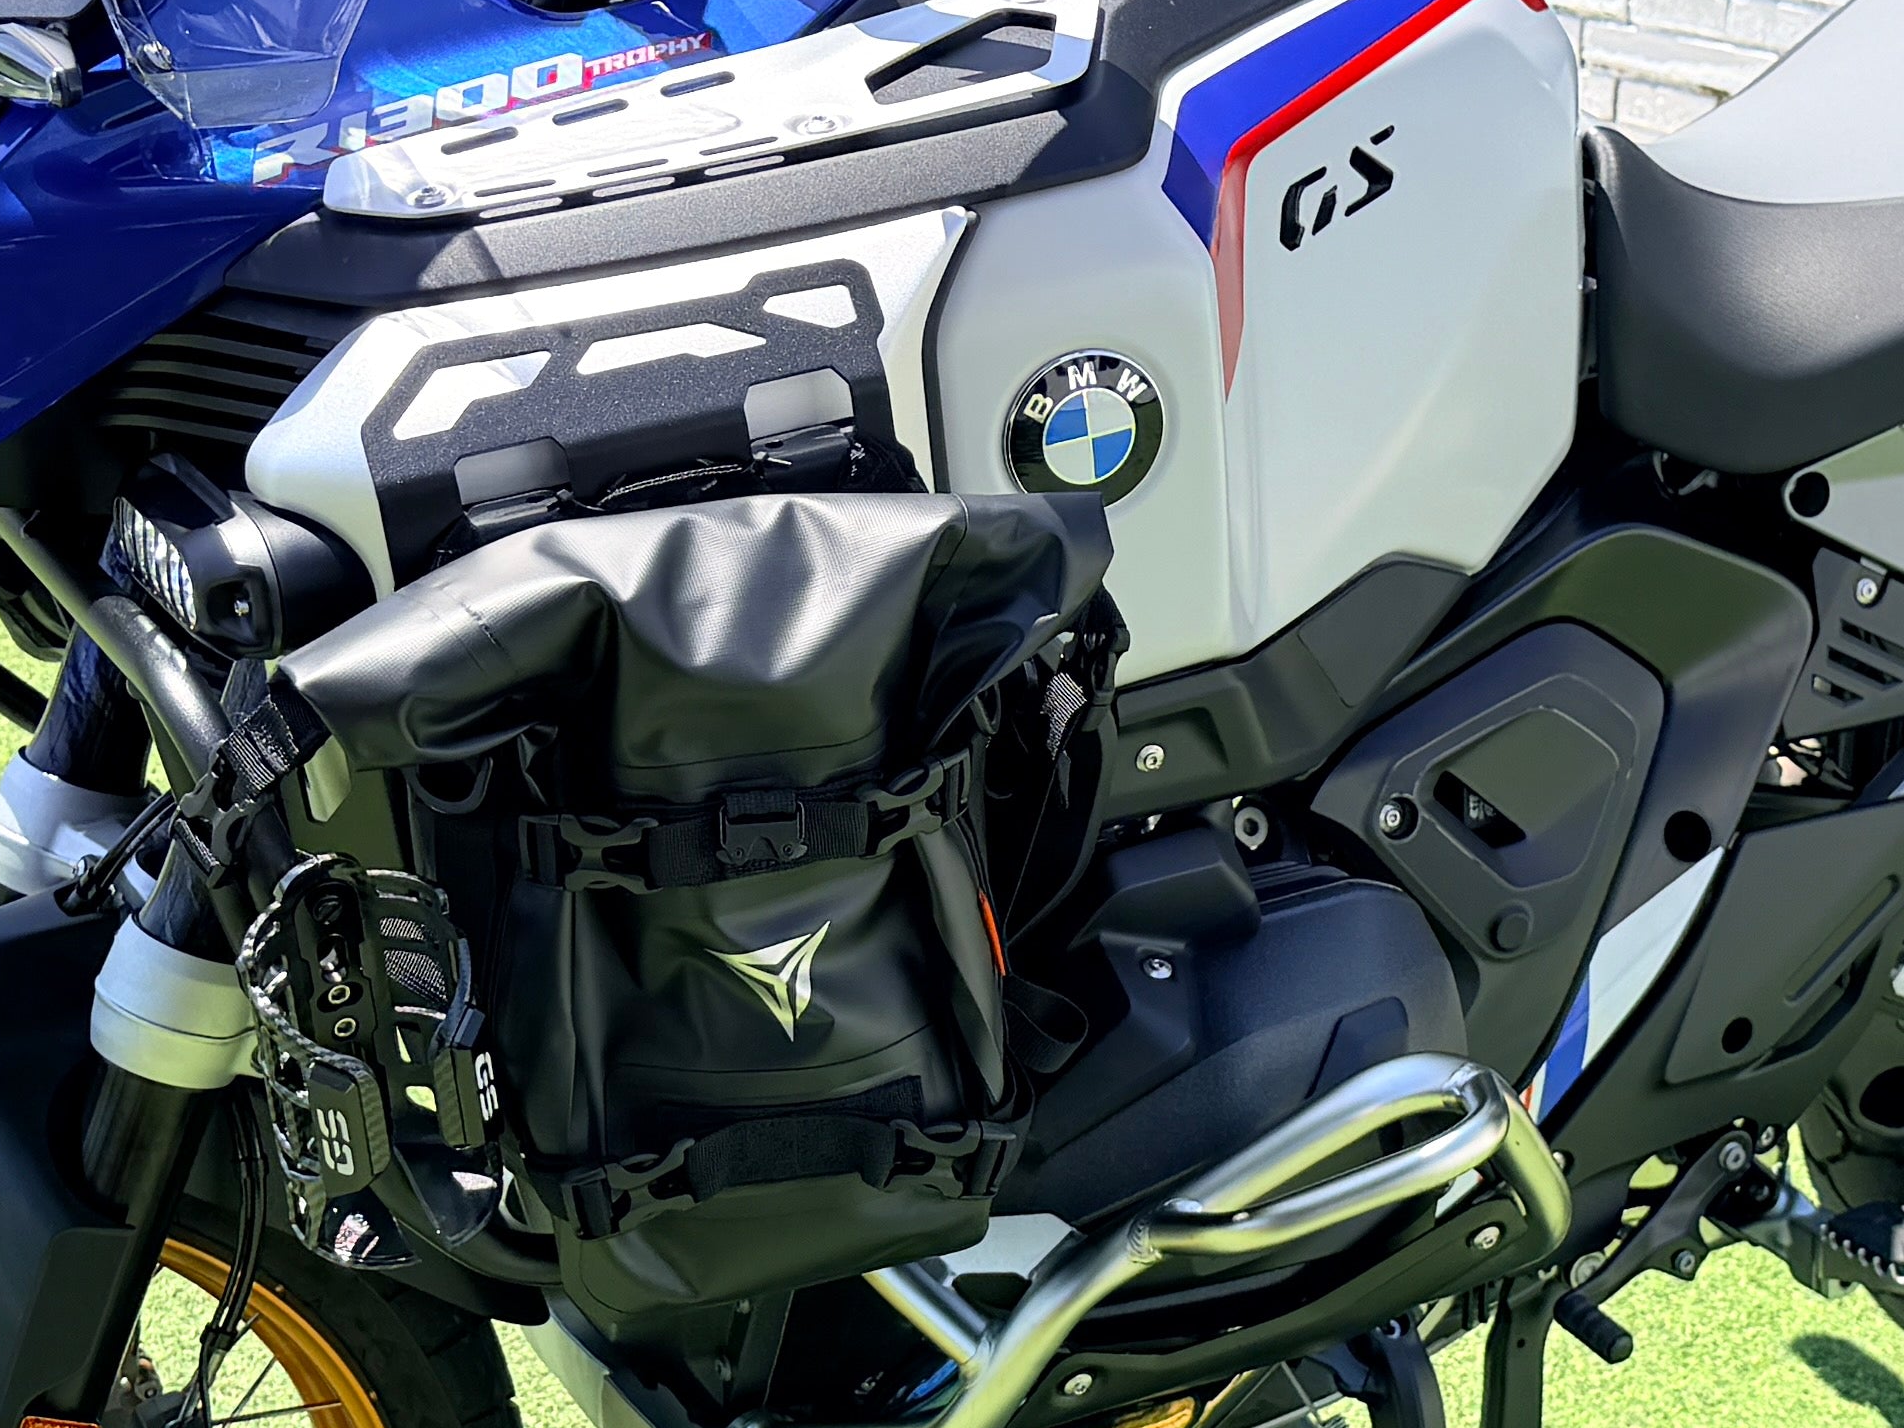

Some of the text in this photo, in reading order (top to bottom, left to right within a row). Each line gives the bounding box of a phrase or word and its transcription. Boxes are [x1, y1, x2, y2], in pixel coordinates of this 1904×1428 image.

[583, 32, 706, 77] TROPHY
[1279, 124, 1395, 252] GS
[1022, 360, 1148, 424] BMW
[474, 1051, 500, 1122] GS
[315, 1108, 356, 1177] GS
